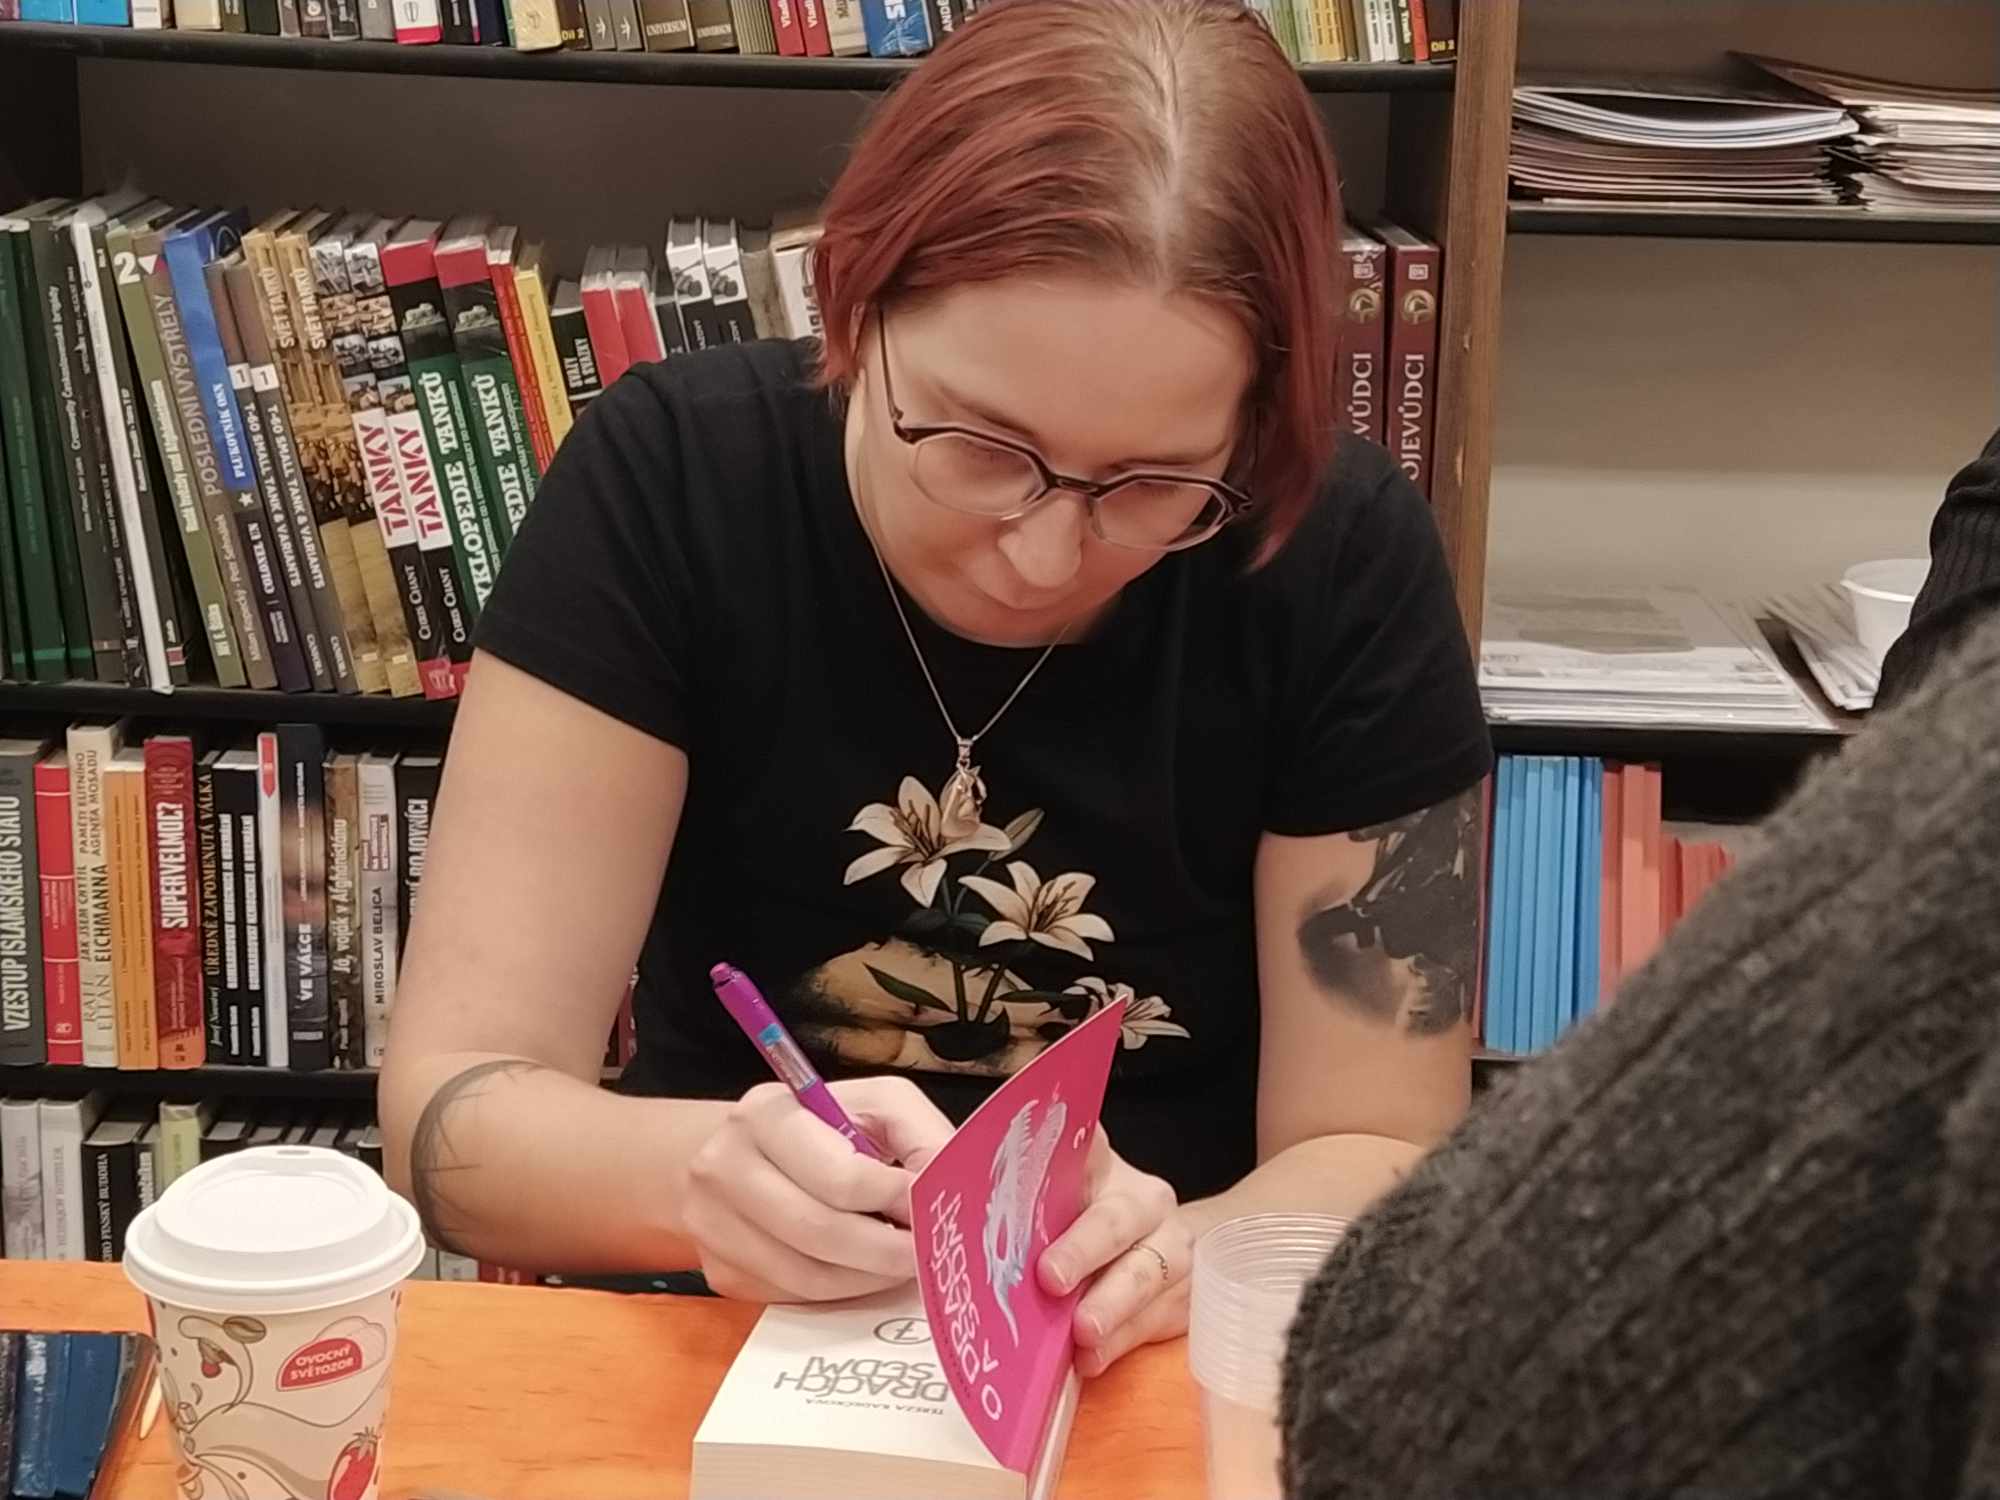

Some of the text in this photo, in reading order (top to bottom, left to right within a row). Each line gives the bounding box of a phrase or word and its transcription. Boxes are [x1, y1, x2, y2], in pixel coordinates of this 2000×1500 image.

[114, 251, 143, 285] 2
[421, 372, 459, 455] TANKŮ
[472, 373, 512, 457] TANKŮ
[1347, 353, 1372, 435] VŮDCI
[181, 396, 220, 497] POSLEDNÍ
[360, 424, 408, 537] TANKY
[395, 426, 442, 539] TANKY
[245, 403, 260, 433] T-60
[253, 434, 271, 475] SMALL
[263, 476, 281, 512] TANK
[276, 525, 300, 587] VARIANTS
[268, 404, 284, 434] T-60
[276, 435, 295, 477] SMALL
[287, 479, 304, 513] TANK
[300, 527, 324, 589] VARIANTS
[75, 751, 88, 852] PAMĚTI ELITNÍHO
[86, 749, 100, 856] AGENTA MOSADU
[156, 802, 189, 929] SUPERVELMOC?
[199, 773, 221, 975] ÚŘEDNĚ ZAPOMENUTÁ VÁLKA
[327, 818, 352, 902] Afghánistánu
[80, 942, 91, 962] JAK
[92, 865, 112, 963] EICHMANNA
[328, 916, 350, 950] voják
[372, 887, 384, 1004] MIROSLAV BELICA
[2, 960, 30, 1031] VZESTUP
[298, 923, 312, 1001] VE VÁLCE
[929, 1189, 982, 1385] DRACÍCH
[290, 1356, 354, 1381] SVĚTOZOR
[295, 1346, 351, 1366] OVOCNÝ
[896, 1321, 919, 1341] 7
[982, 1338, 1003, 1377] A
[772, 1372, 949, 1402] DRACÍCH
[981, 1384, 1003, 1421] O
